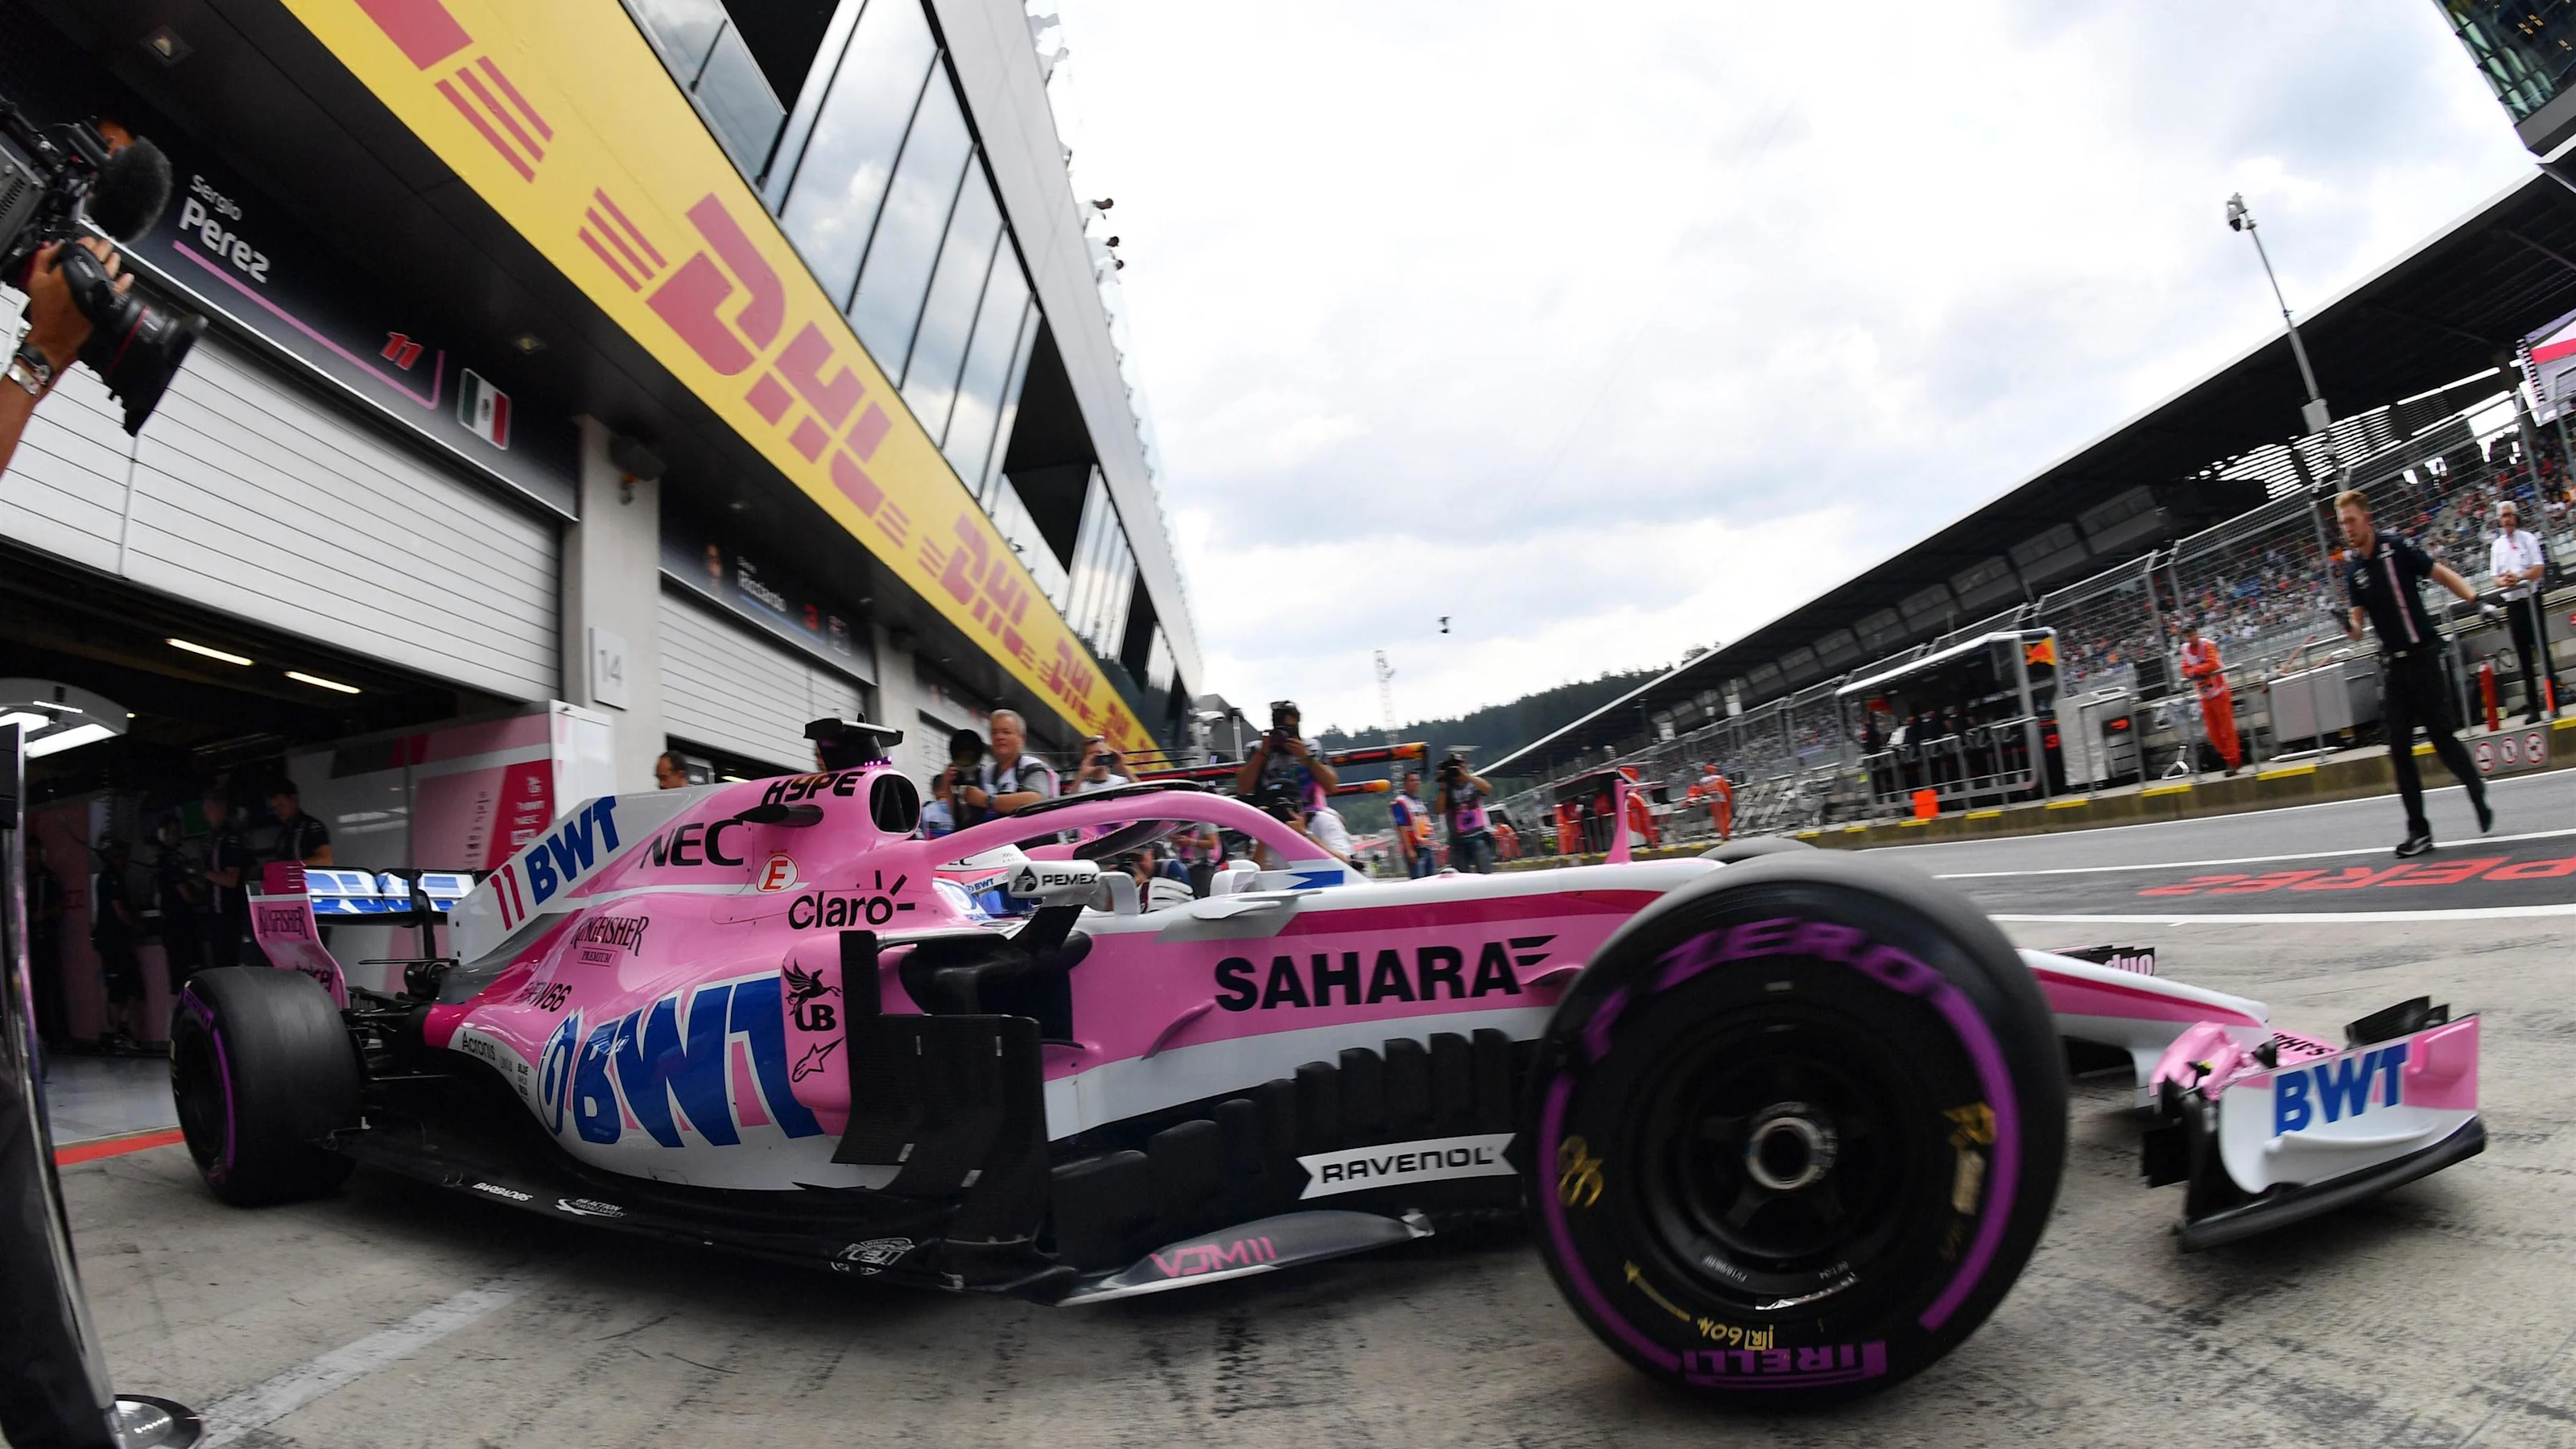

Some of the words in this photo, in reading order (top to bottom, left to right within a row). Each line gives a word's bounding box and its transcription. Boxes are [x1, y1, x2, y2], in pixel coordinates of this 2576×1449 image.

[190, 175, 242, 221] Sergio
[179, 197, 270, 283] Perez
[380, 332, 423, 370] 11
[645, 192, 894, 527] DHL
[939, 513, 1031, 658] DHL
[599, 649, 623, 687] 14
[761, 771, 866, 806] HYPE
[489, 864, 526, 931] 11
[525, 795, 621, 906] BWT
[640, 819, 744, 869] NEC
[763, 860, 788, 890] E
[975, 877, 994, 890] BWT
[1042, 873, 1097, 886] PEMEX
[2137, 856, 2576, 896] PEREZ
[788, 891, 894, 930] Claro
[571, 916, 650, 956] KINGFISHER
[581, 950, 612, 964] PREMIUM
[1214, 941, 1523, 1012] SAHARA
[462, 1031, 496, 1061] Acronis
[572, 976, 824, 1148] BWT
[2273, 1042, 2408, 1138] BWT
[1321, 1147, 1496, 1184] RAVENOL
[1150, 1236, 1278, 1278] VJM11
[1683, 1340, 1888, 1388] PIRELLI
